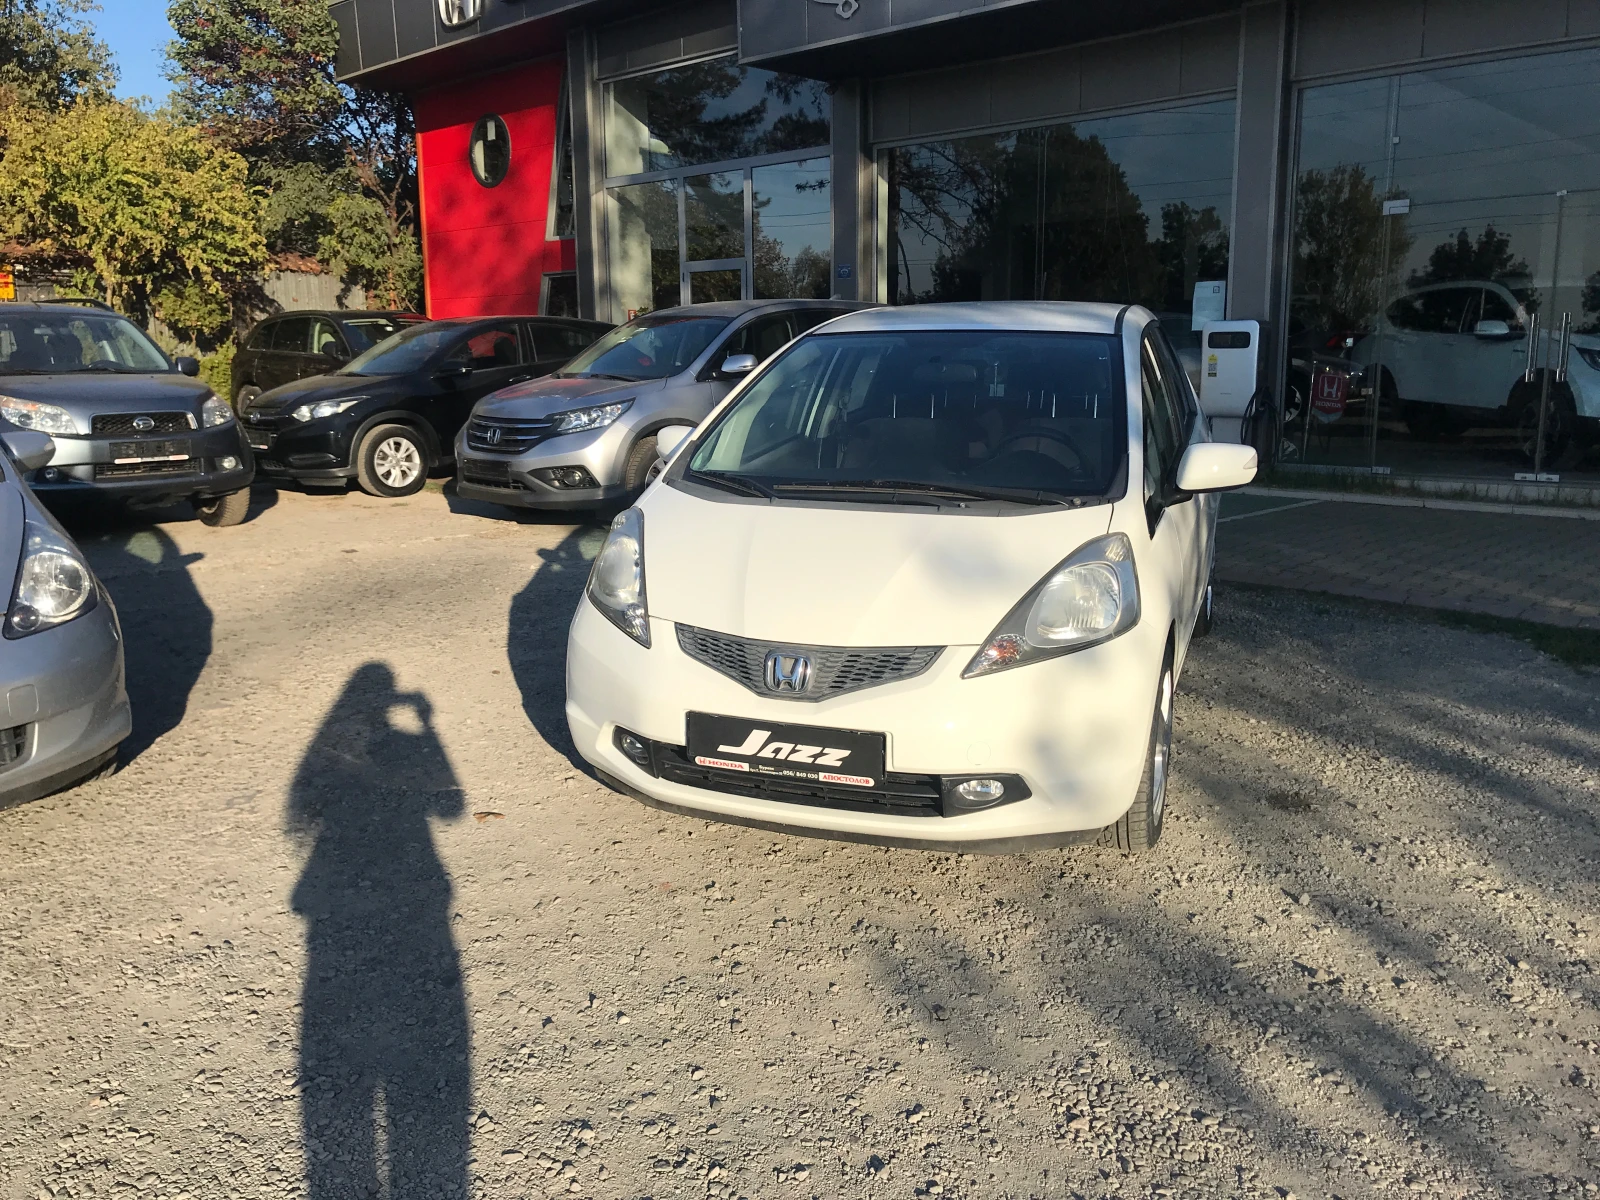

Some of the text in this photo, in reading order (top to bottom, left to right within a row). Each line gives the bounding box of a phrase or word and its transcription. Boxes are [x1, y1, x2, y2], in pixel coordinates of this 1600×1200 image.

[1315, 400, 1342, 408] HONDA
[708, 759, 745, 769] HONDA
[822, 774, 870, 785] АПОСТОЛОВ
